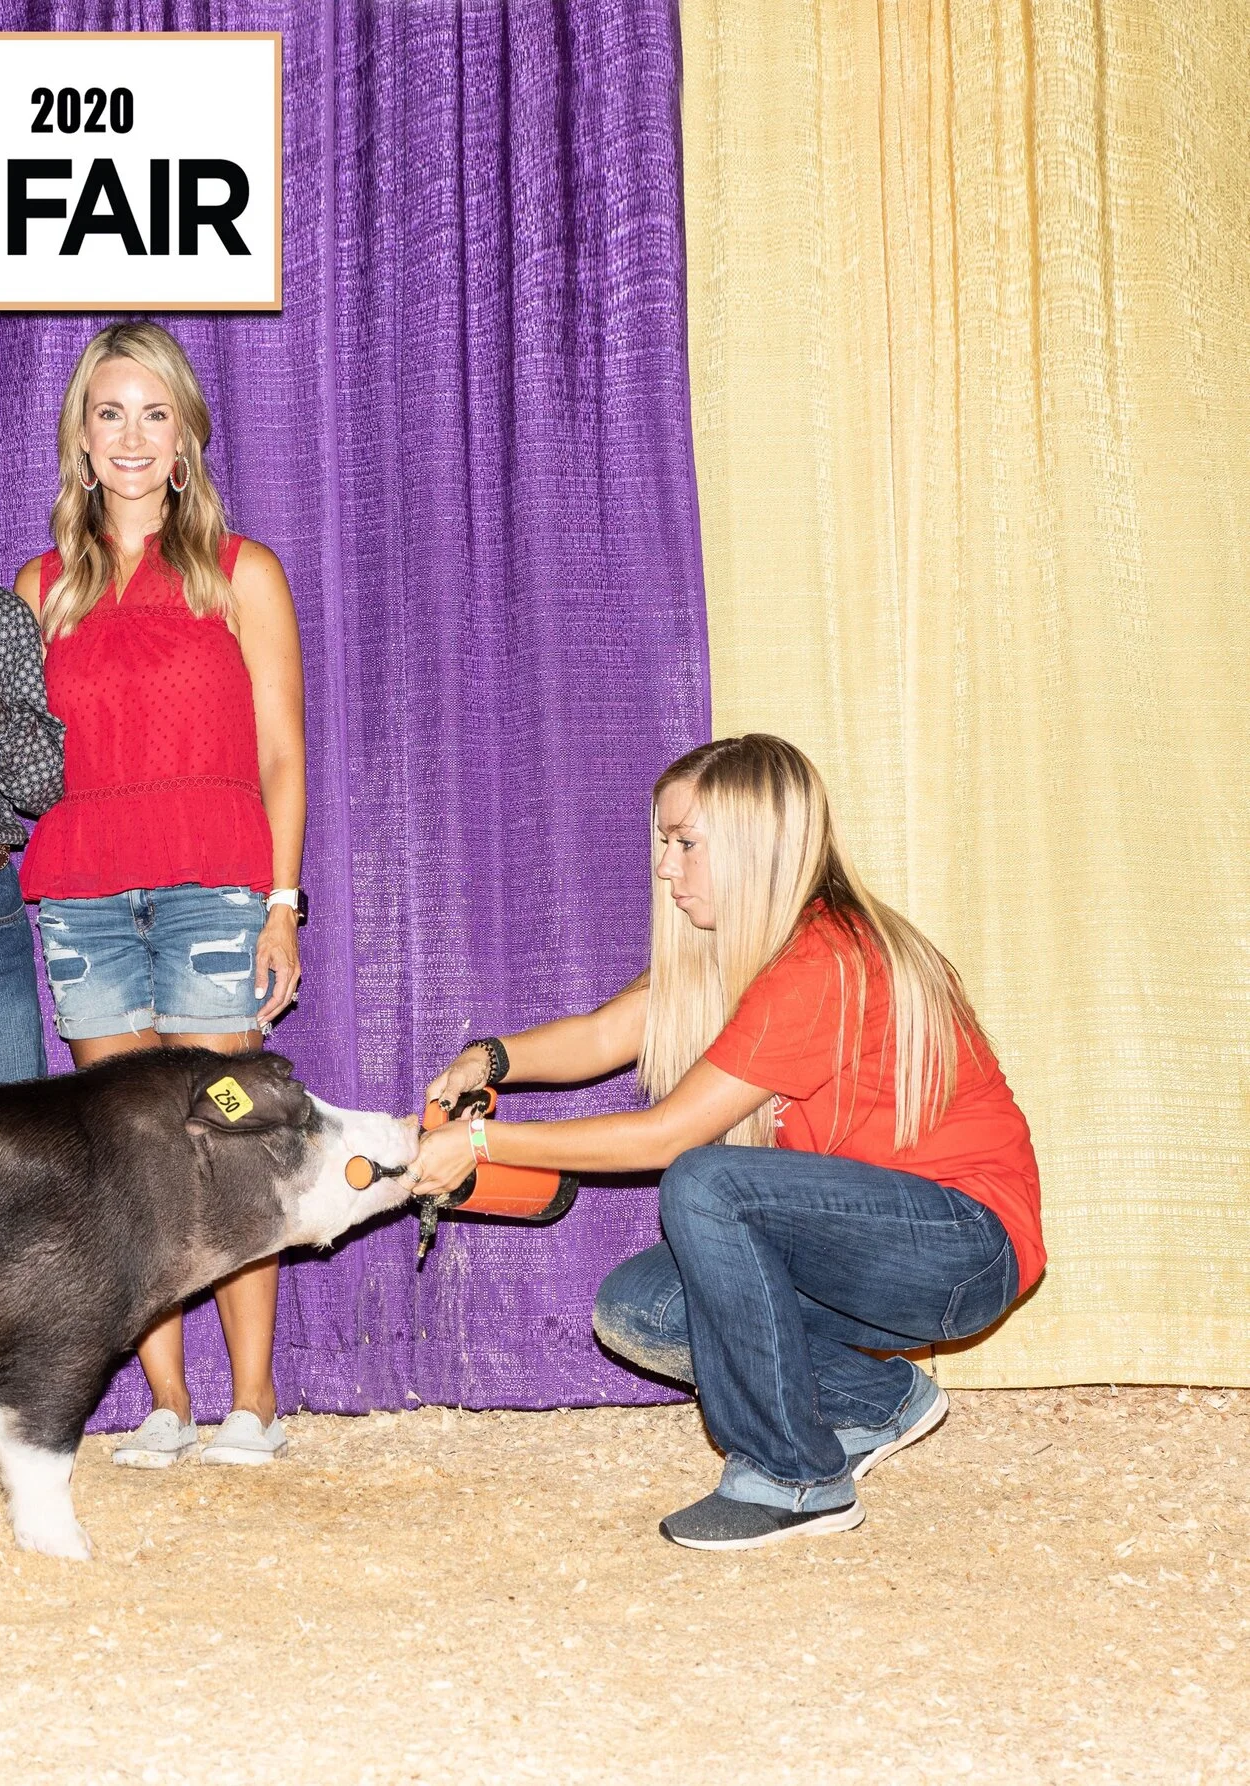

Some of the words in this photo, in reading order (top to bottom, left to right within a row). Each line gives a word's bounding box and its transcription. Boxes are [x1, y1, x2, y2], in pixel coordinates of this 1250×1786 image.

[30, 87, 134, 134] 2020
[7, 157, 252, 256] FAIR
[214, 1089, 241, 1113] 250
